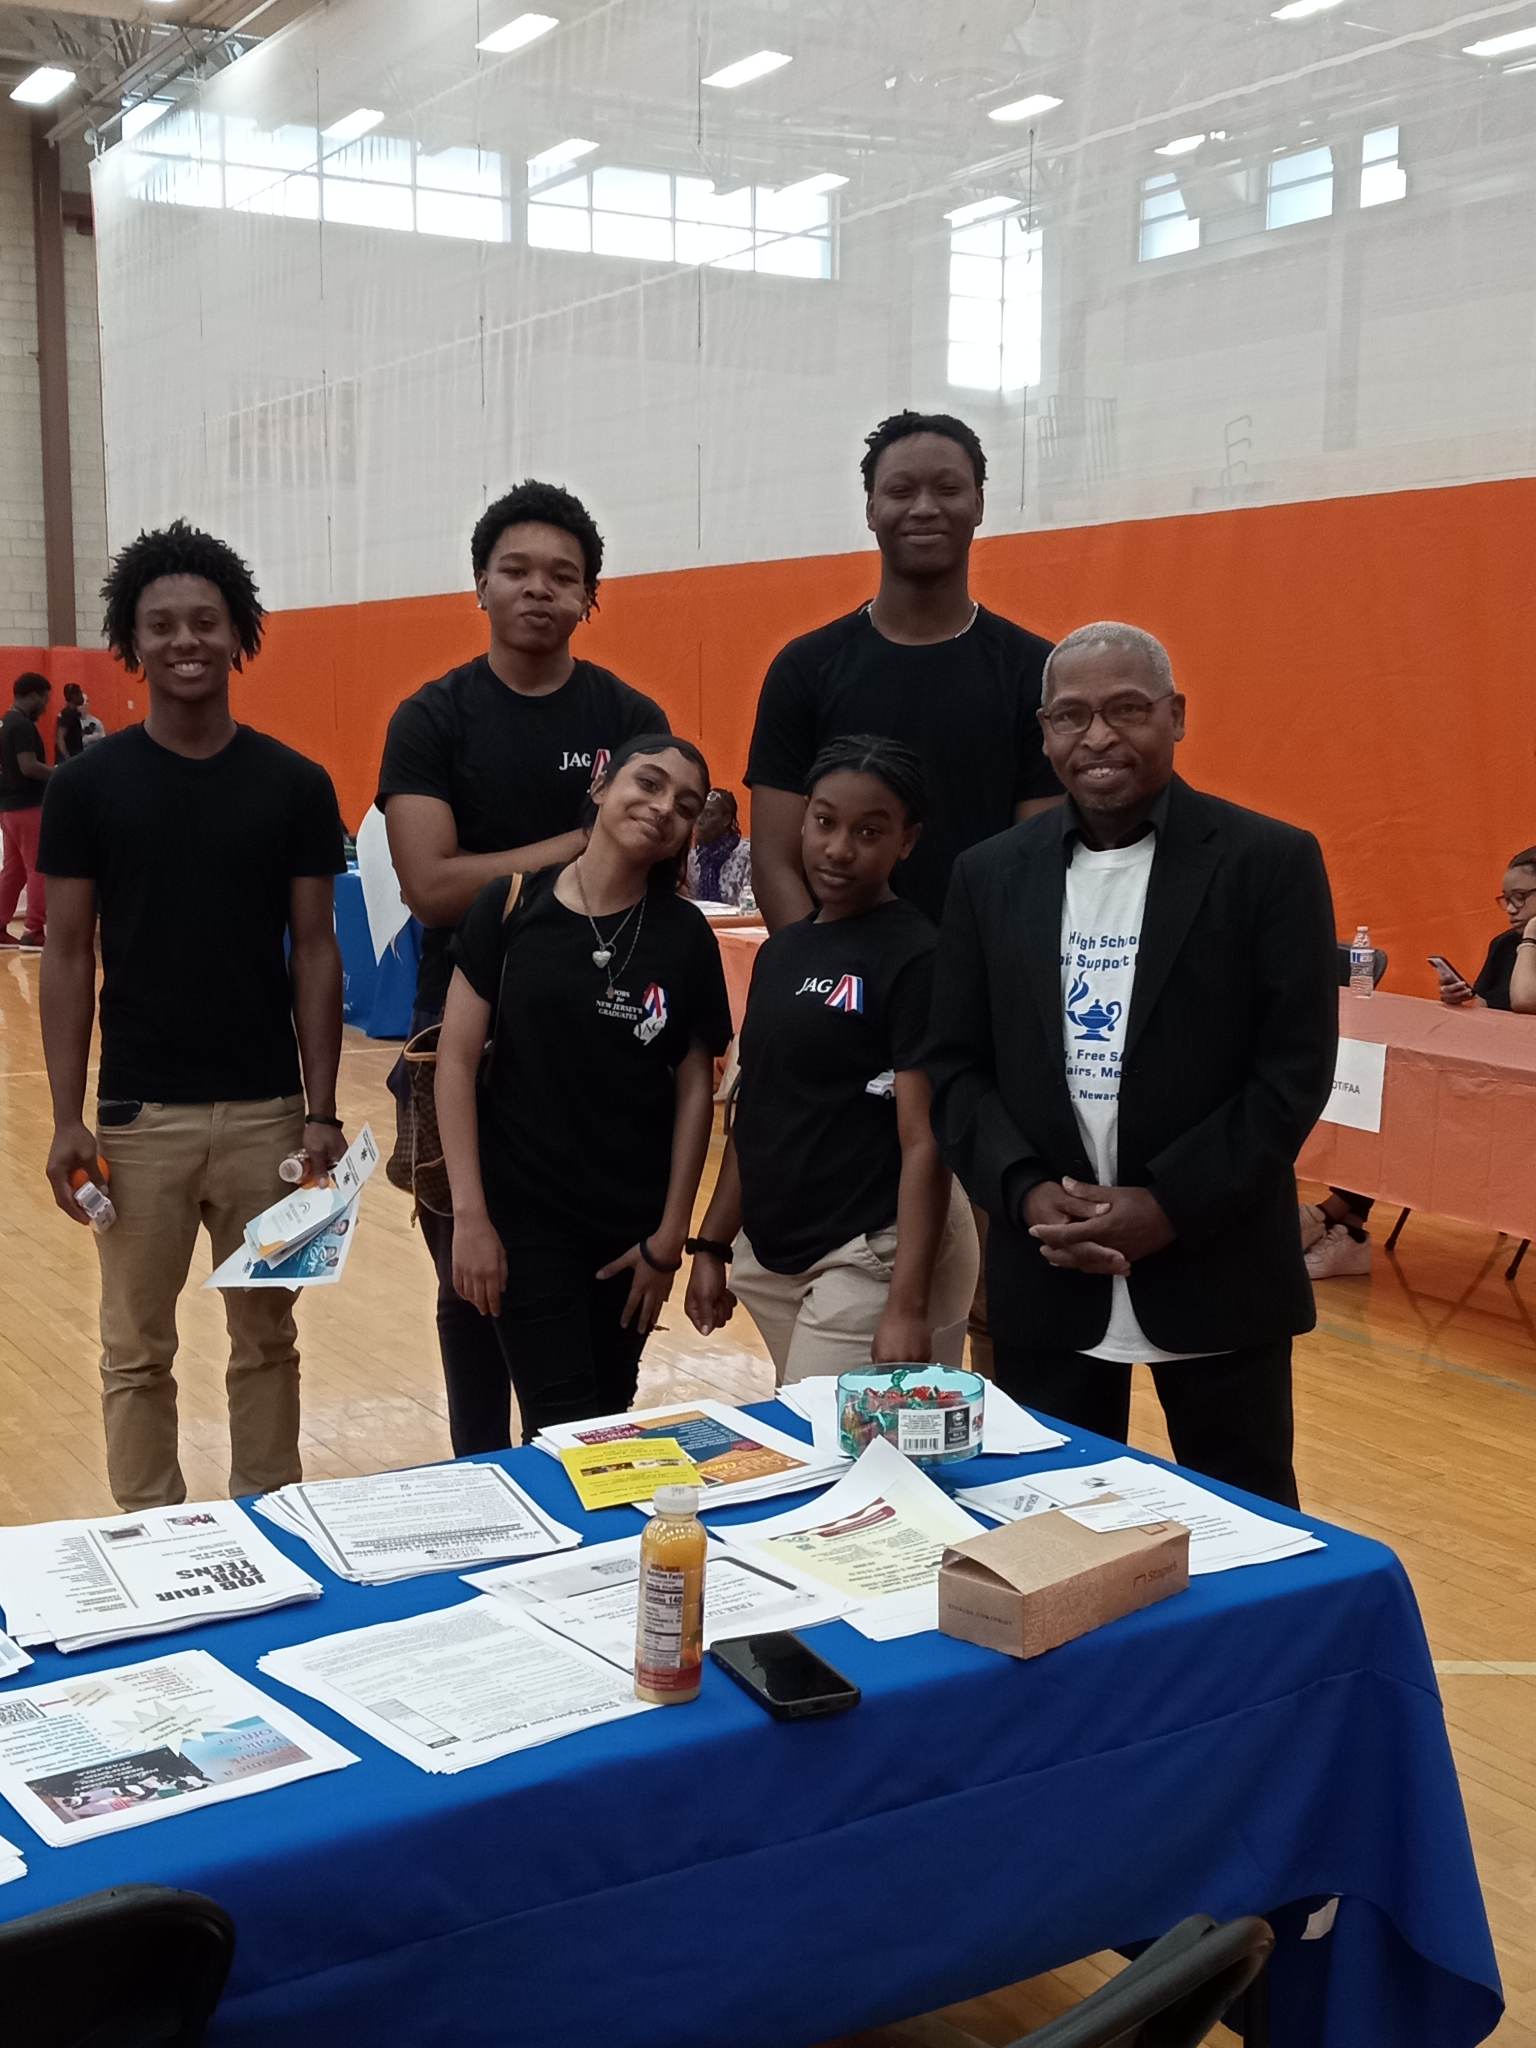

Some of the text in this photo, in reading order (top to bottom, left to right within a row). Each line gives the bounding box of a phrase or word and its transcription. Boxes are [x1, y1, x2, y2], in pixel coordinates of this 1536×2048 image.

[558, 751, 592, 771] JAG
[1068, 931, 1096, 951] High
[795, 977, 834, 996] JAG
[596, 999, 613, 1009] NEW
[598, 1008, 638, 1021] GRADUATES
[1076, 1048, 1106, 1062] Free
[175, 1559, 253, 1580] TEENS
[210, 1566, 261, 1583] FOR
[155, 1573, 266, 1602] JOB FAIR
[216, 1728, 273, 1746] Officer
